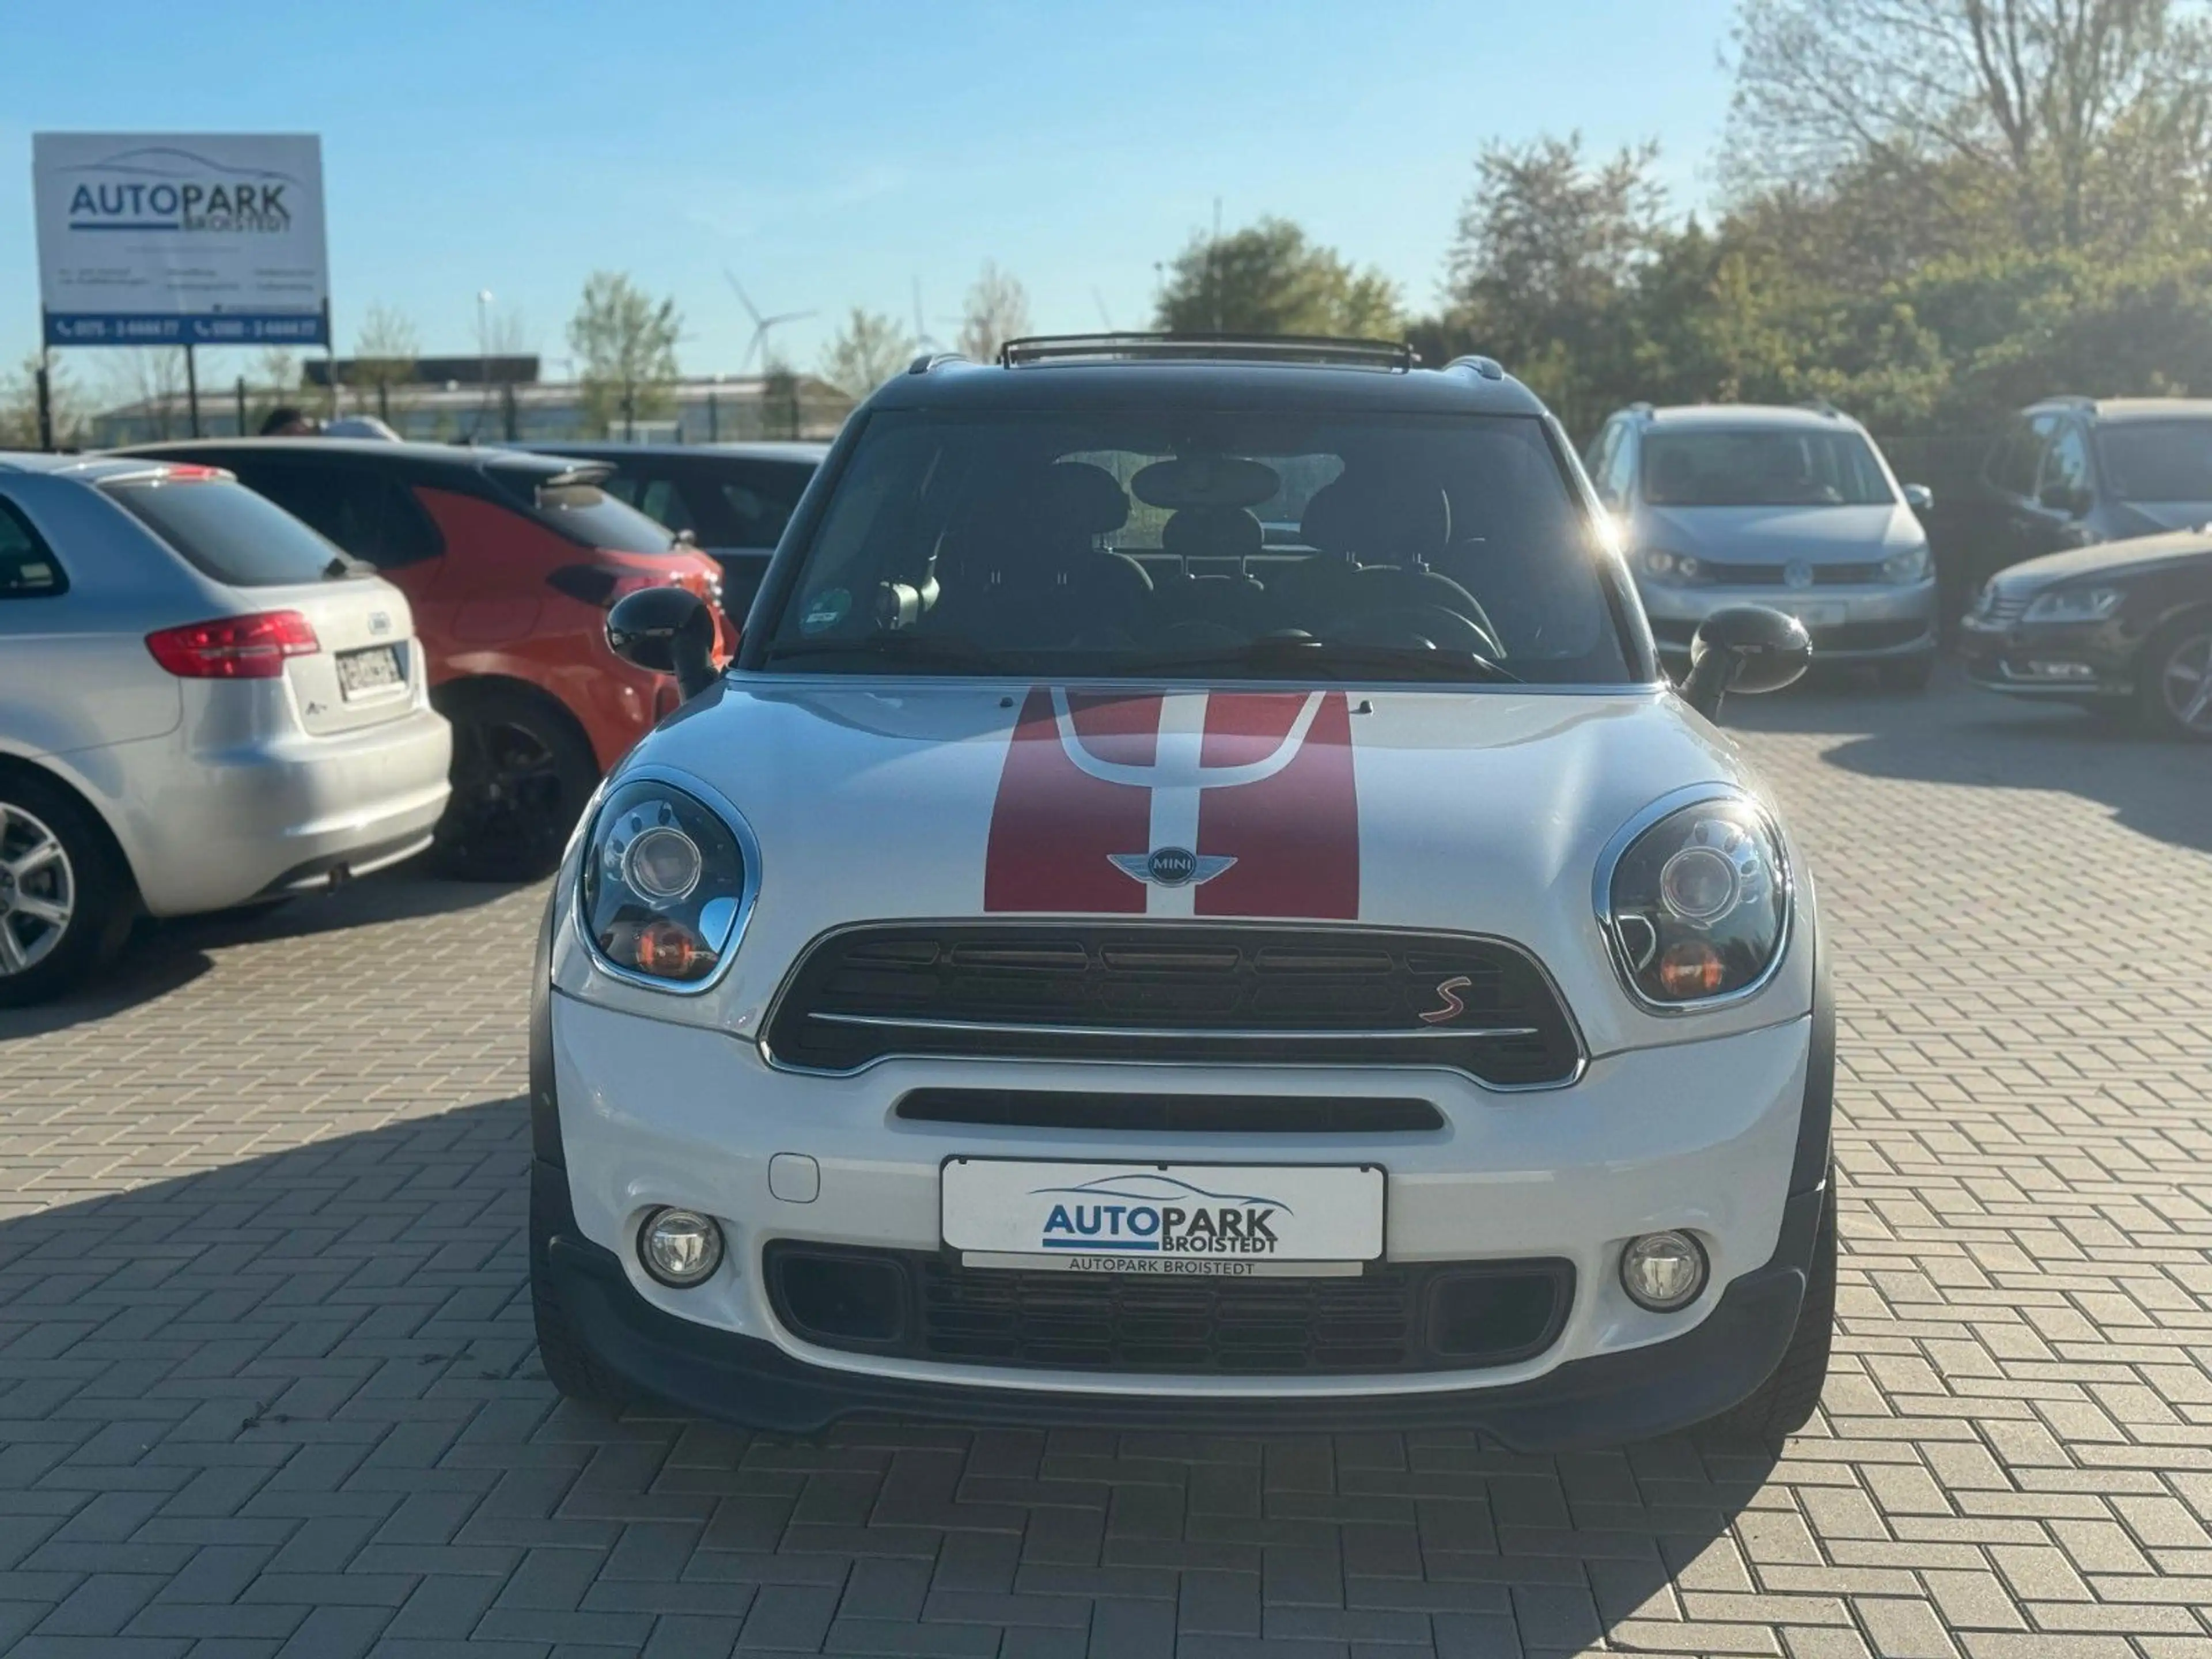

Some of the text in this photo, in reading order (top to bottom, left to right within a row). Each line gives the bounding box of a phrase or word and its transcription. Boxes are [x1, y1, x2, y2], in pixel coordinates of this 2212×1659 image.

[69, 183, 289, 218] AUTOPARK
[1153, 857, 1192, 870] MINI
[1418, 976, 1472, 1022] S
[1043, 1205, 1277, 1240] AUTOPARK
[1162, 1236, 1278, 1253] BROISTEDT
[1069, 1257, 1255, 1275] AUTOPARK BROISTEDT
